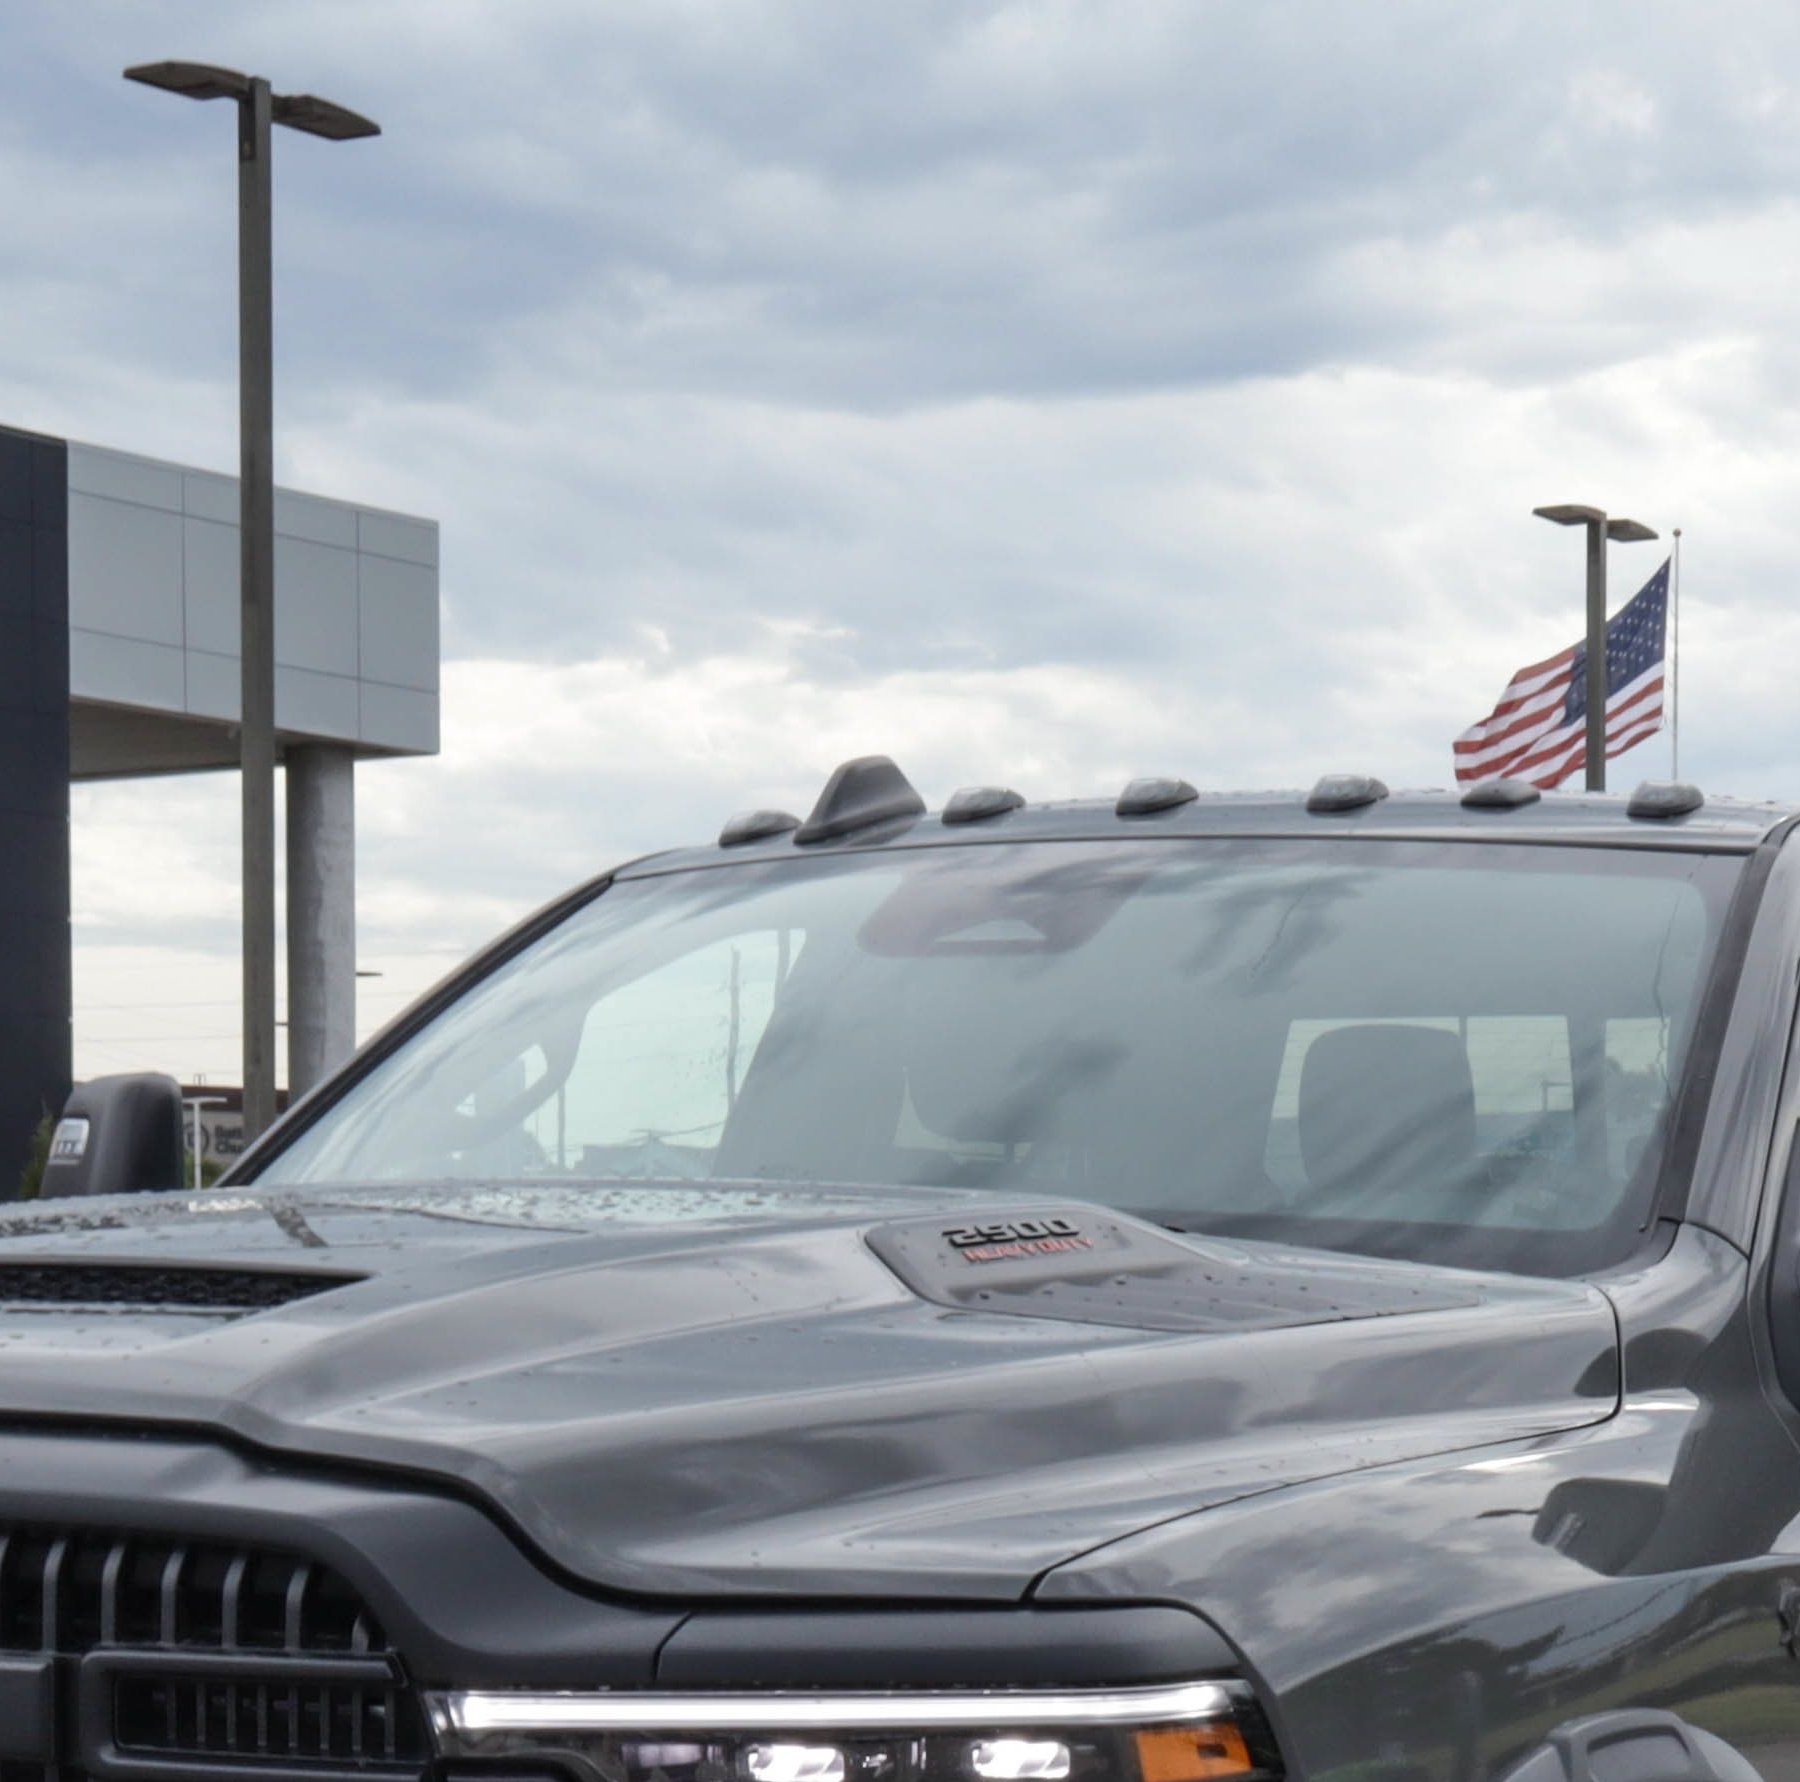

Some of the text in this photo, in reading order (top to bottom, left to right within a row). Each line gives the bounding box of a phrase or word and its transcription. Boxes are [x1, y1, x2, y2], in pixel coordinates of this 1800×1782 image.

[942, 1218, 1080, 1249] 2500
[962, 1238, 1094, 1263] HEAVY DUTY
